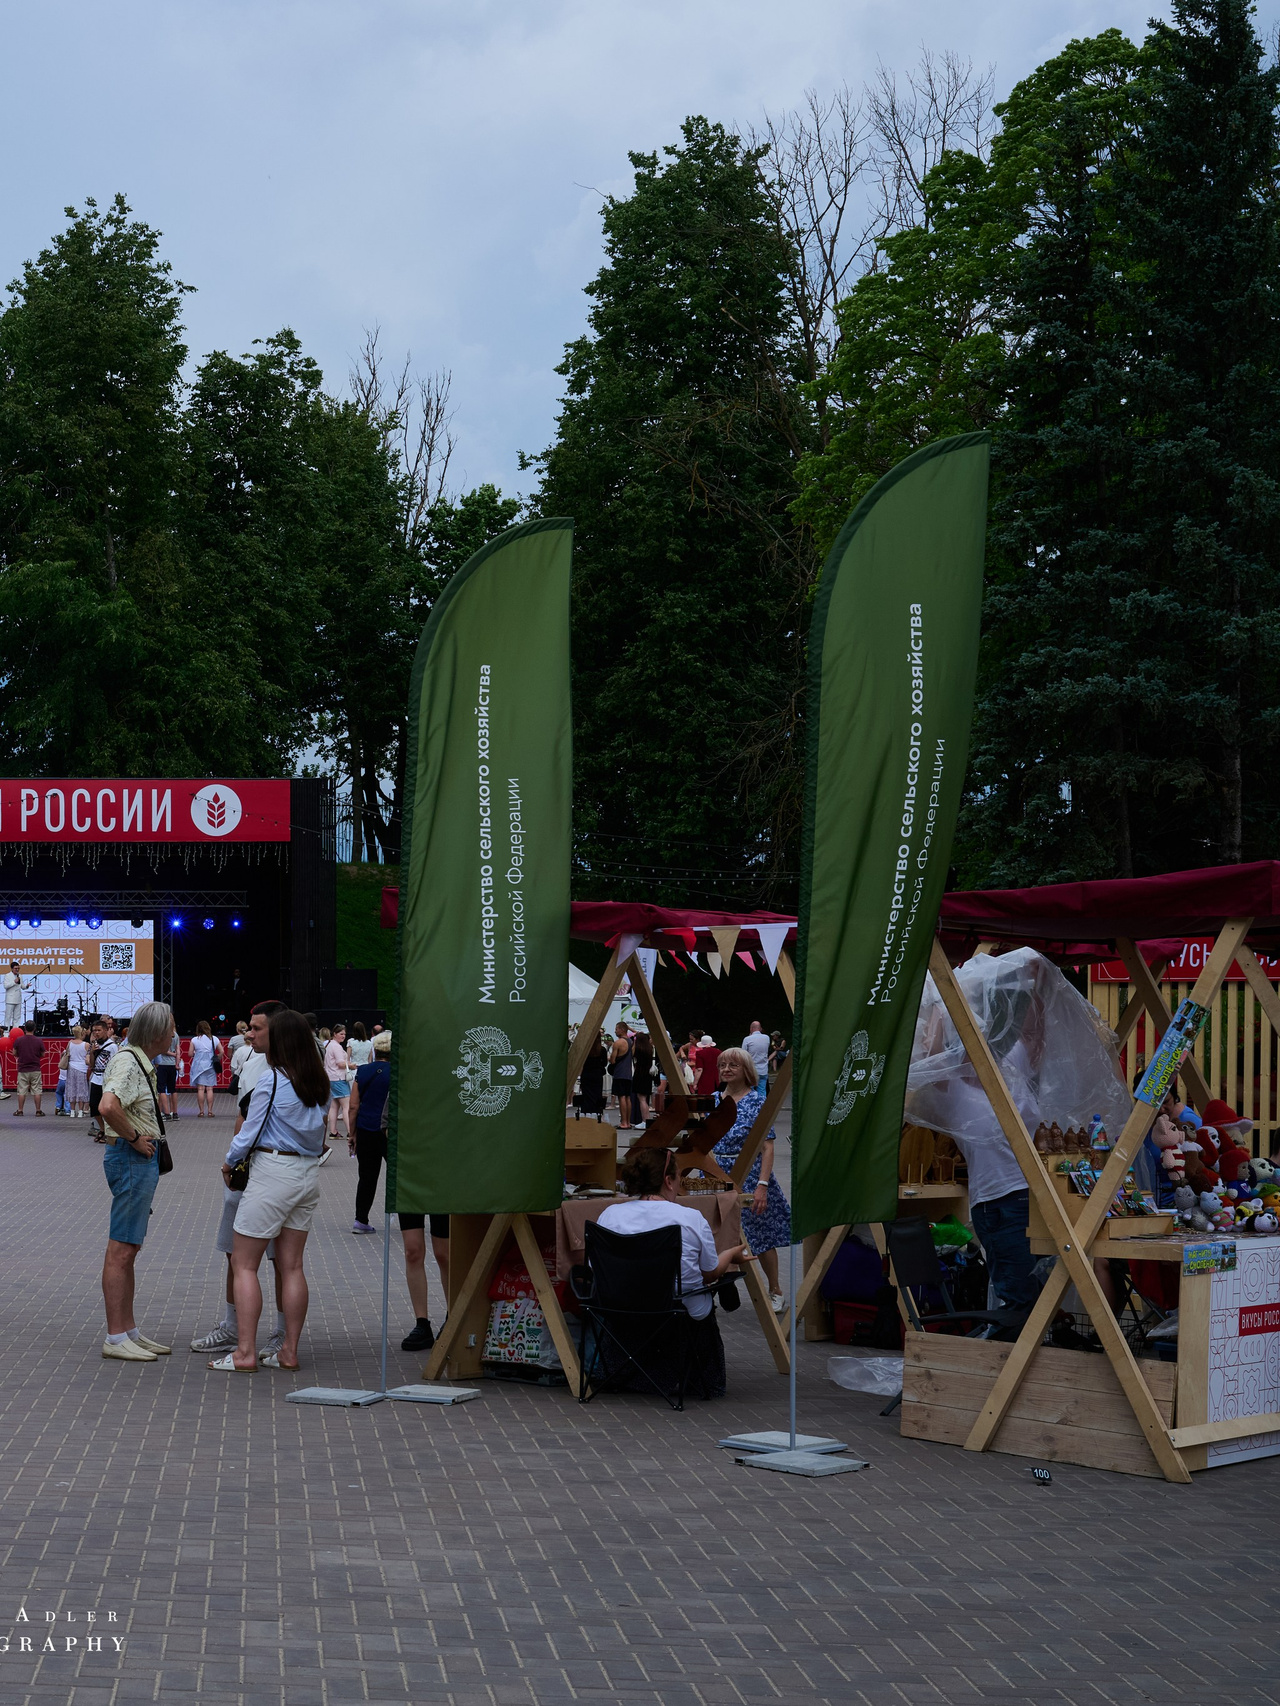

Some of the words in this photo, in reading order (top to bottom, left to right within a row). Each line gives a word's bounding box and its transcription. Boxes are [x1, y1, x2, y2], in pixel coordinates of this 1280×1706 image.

[906, 603, 924, 716] хозяйства
[474, 664, 491, 760] хозяйства
[21, 788, 172, 832] РОССИИ
[478, 764, 493, 860] сельского
[901, 722, 922, 838] сельского
[505, 778, 527, 885] Федерации
[880, 877, 924, 1003] Российской
[917, 738, 945, 870] Федерации
[57, 958, 66, 966] В
[68, 958, 85, 966] ВК
[479, 865, 498, 1004] Министерство
[508, 890, 526, 1003] Российской
[867, 844, 910, 1006] Министерство
[1143, 1050, 1170, 1095] МАГНИТЫ
[1153, 1048, 1183, 1097] СМОЛЕНСК
[1241, 1312, 1263, 1329] ВКУСЫ
[1034, 1468, 1050, 1479] 100
